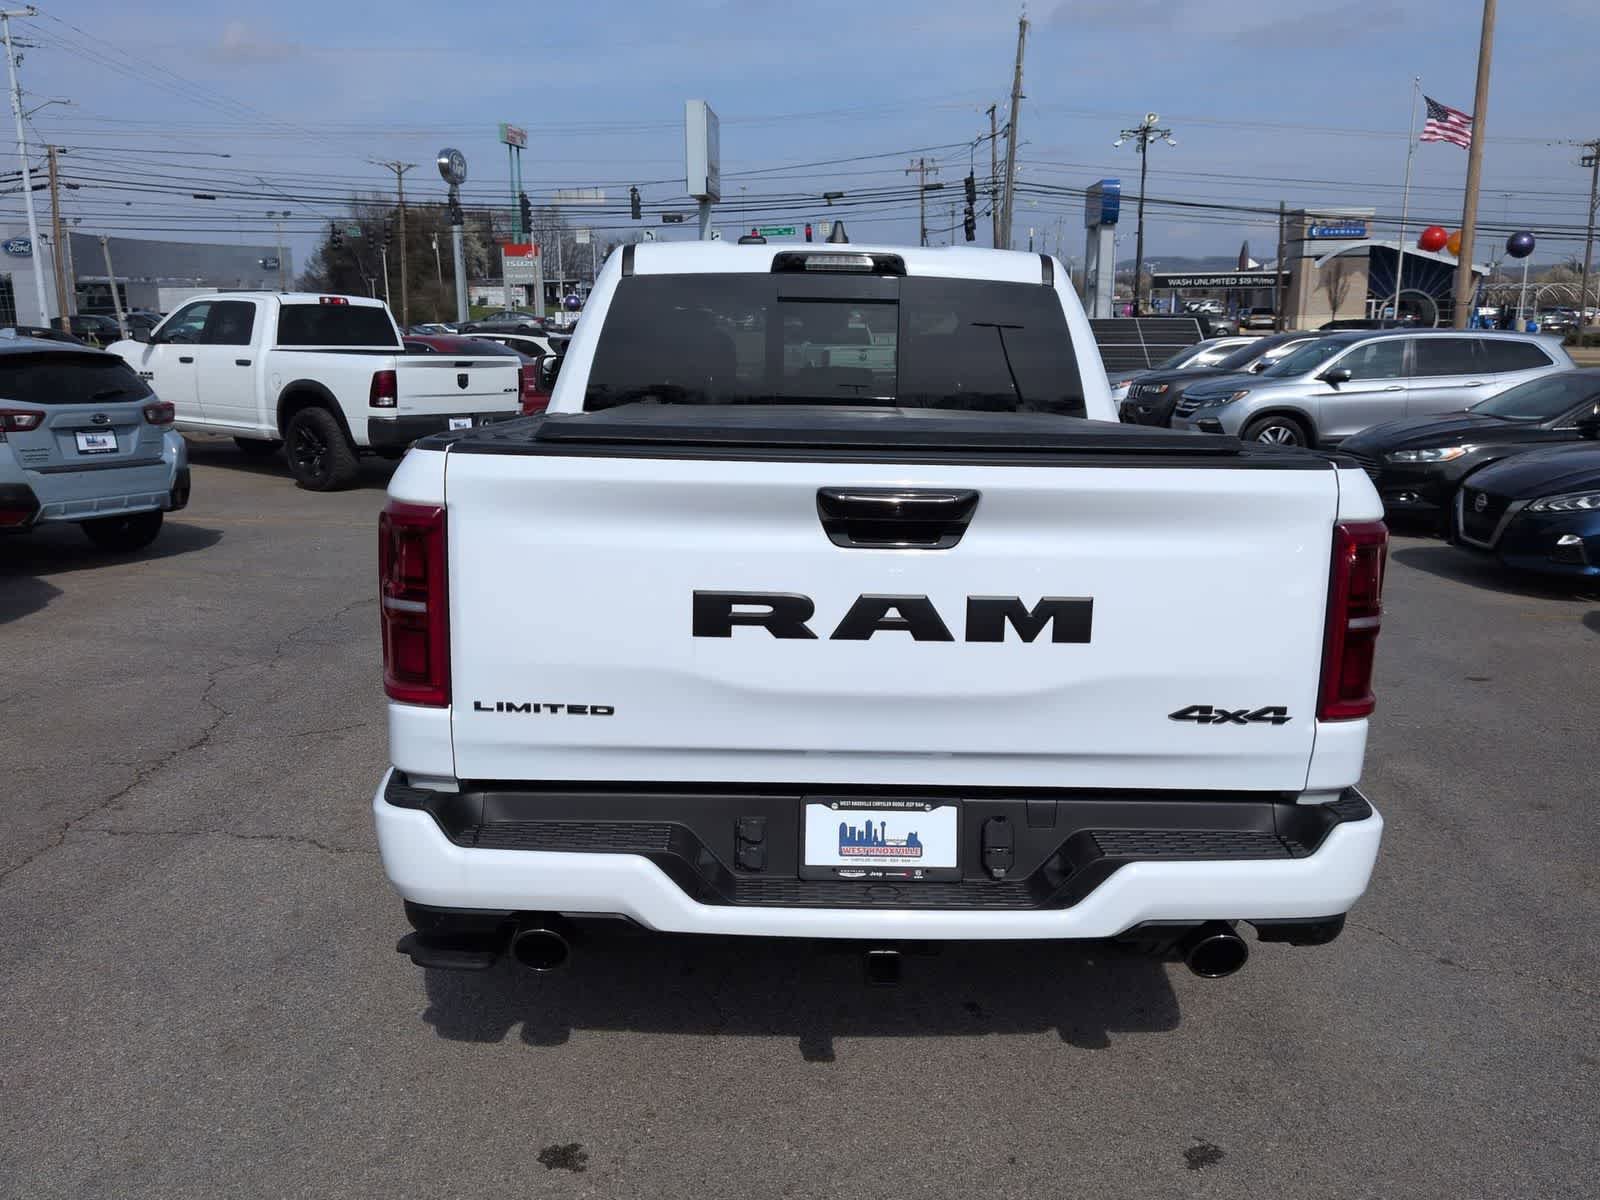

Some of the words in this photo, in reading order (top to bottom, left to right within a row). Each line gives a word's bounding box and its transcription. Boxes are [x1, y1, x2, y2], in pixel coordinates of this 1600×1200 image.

[1167, 278, 1192, 287] WASH
[1193, 278, 1237, 286] UNLIMITED
[692, 590, 1094, 643] RAM
[473, 701, 615, 716] LIMITED
[842, 847, 868, 855] WEST
[868, 847, 921, 855] KNOXVILLE
